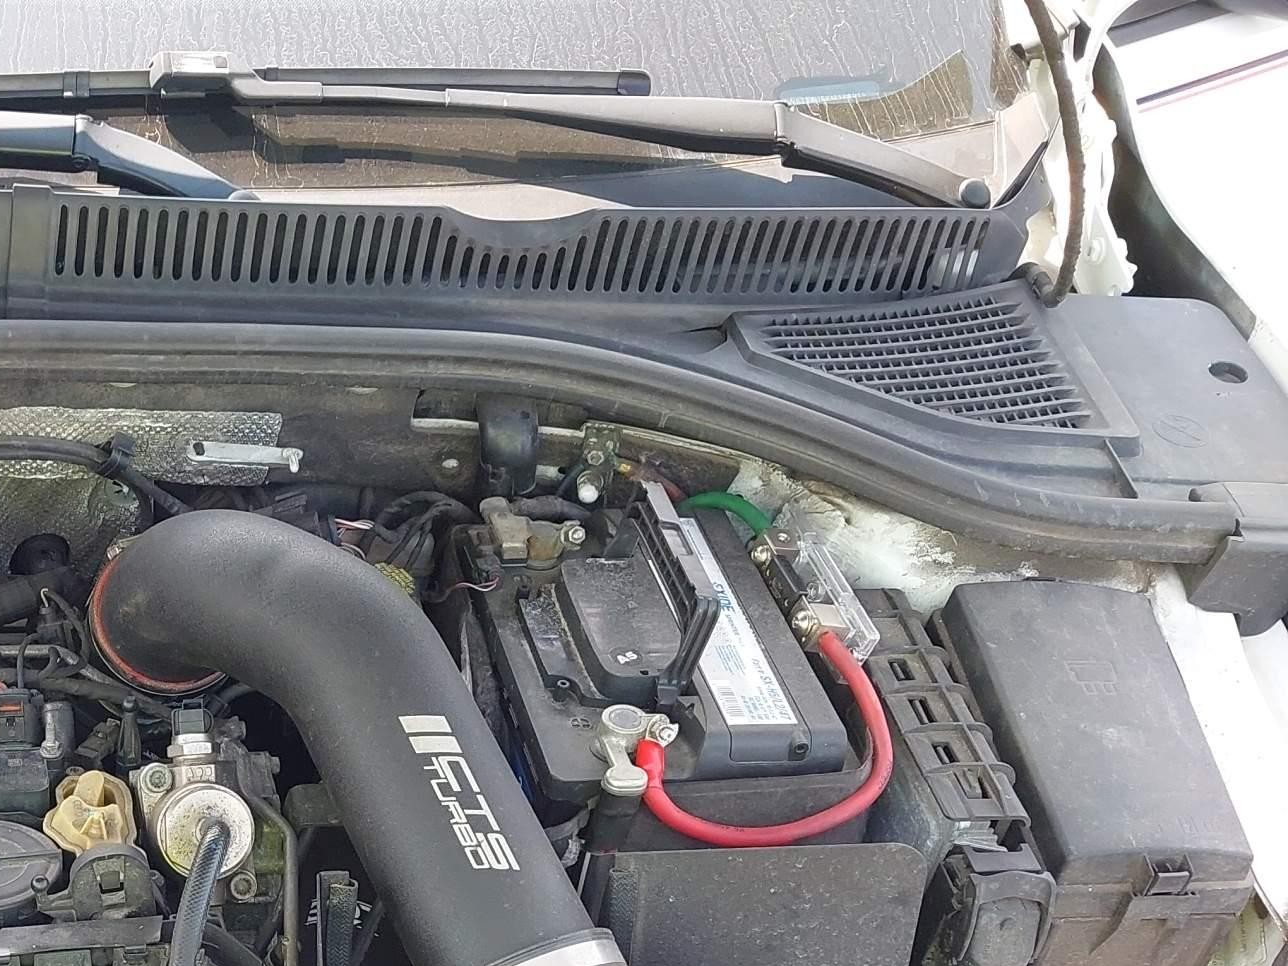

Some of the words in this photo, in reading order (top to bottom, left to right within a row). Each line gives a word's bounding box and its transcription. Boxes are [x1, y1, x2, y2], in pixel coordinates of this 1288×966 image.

[617, 651, 638, 665] A5
[423, 757, 491, 869] TURBO
[438, 756, 520, 871] CTS
